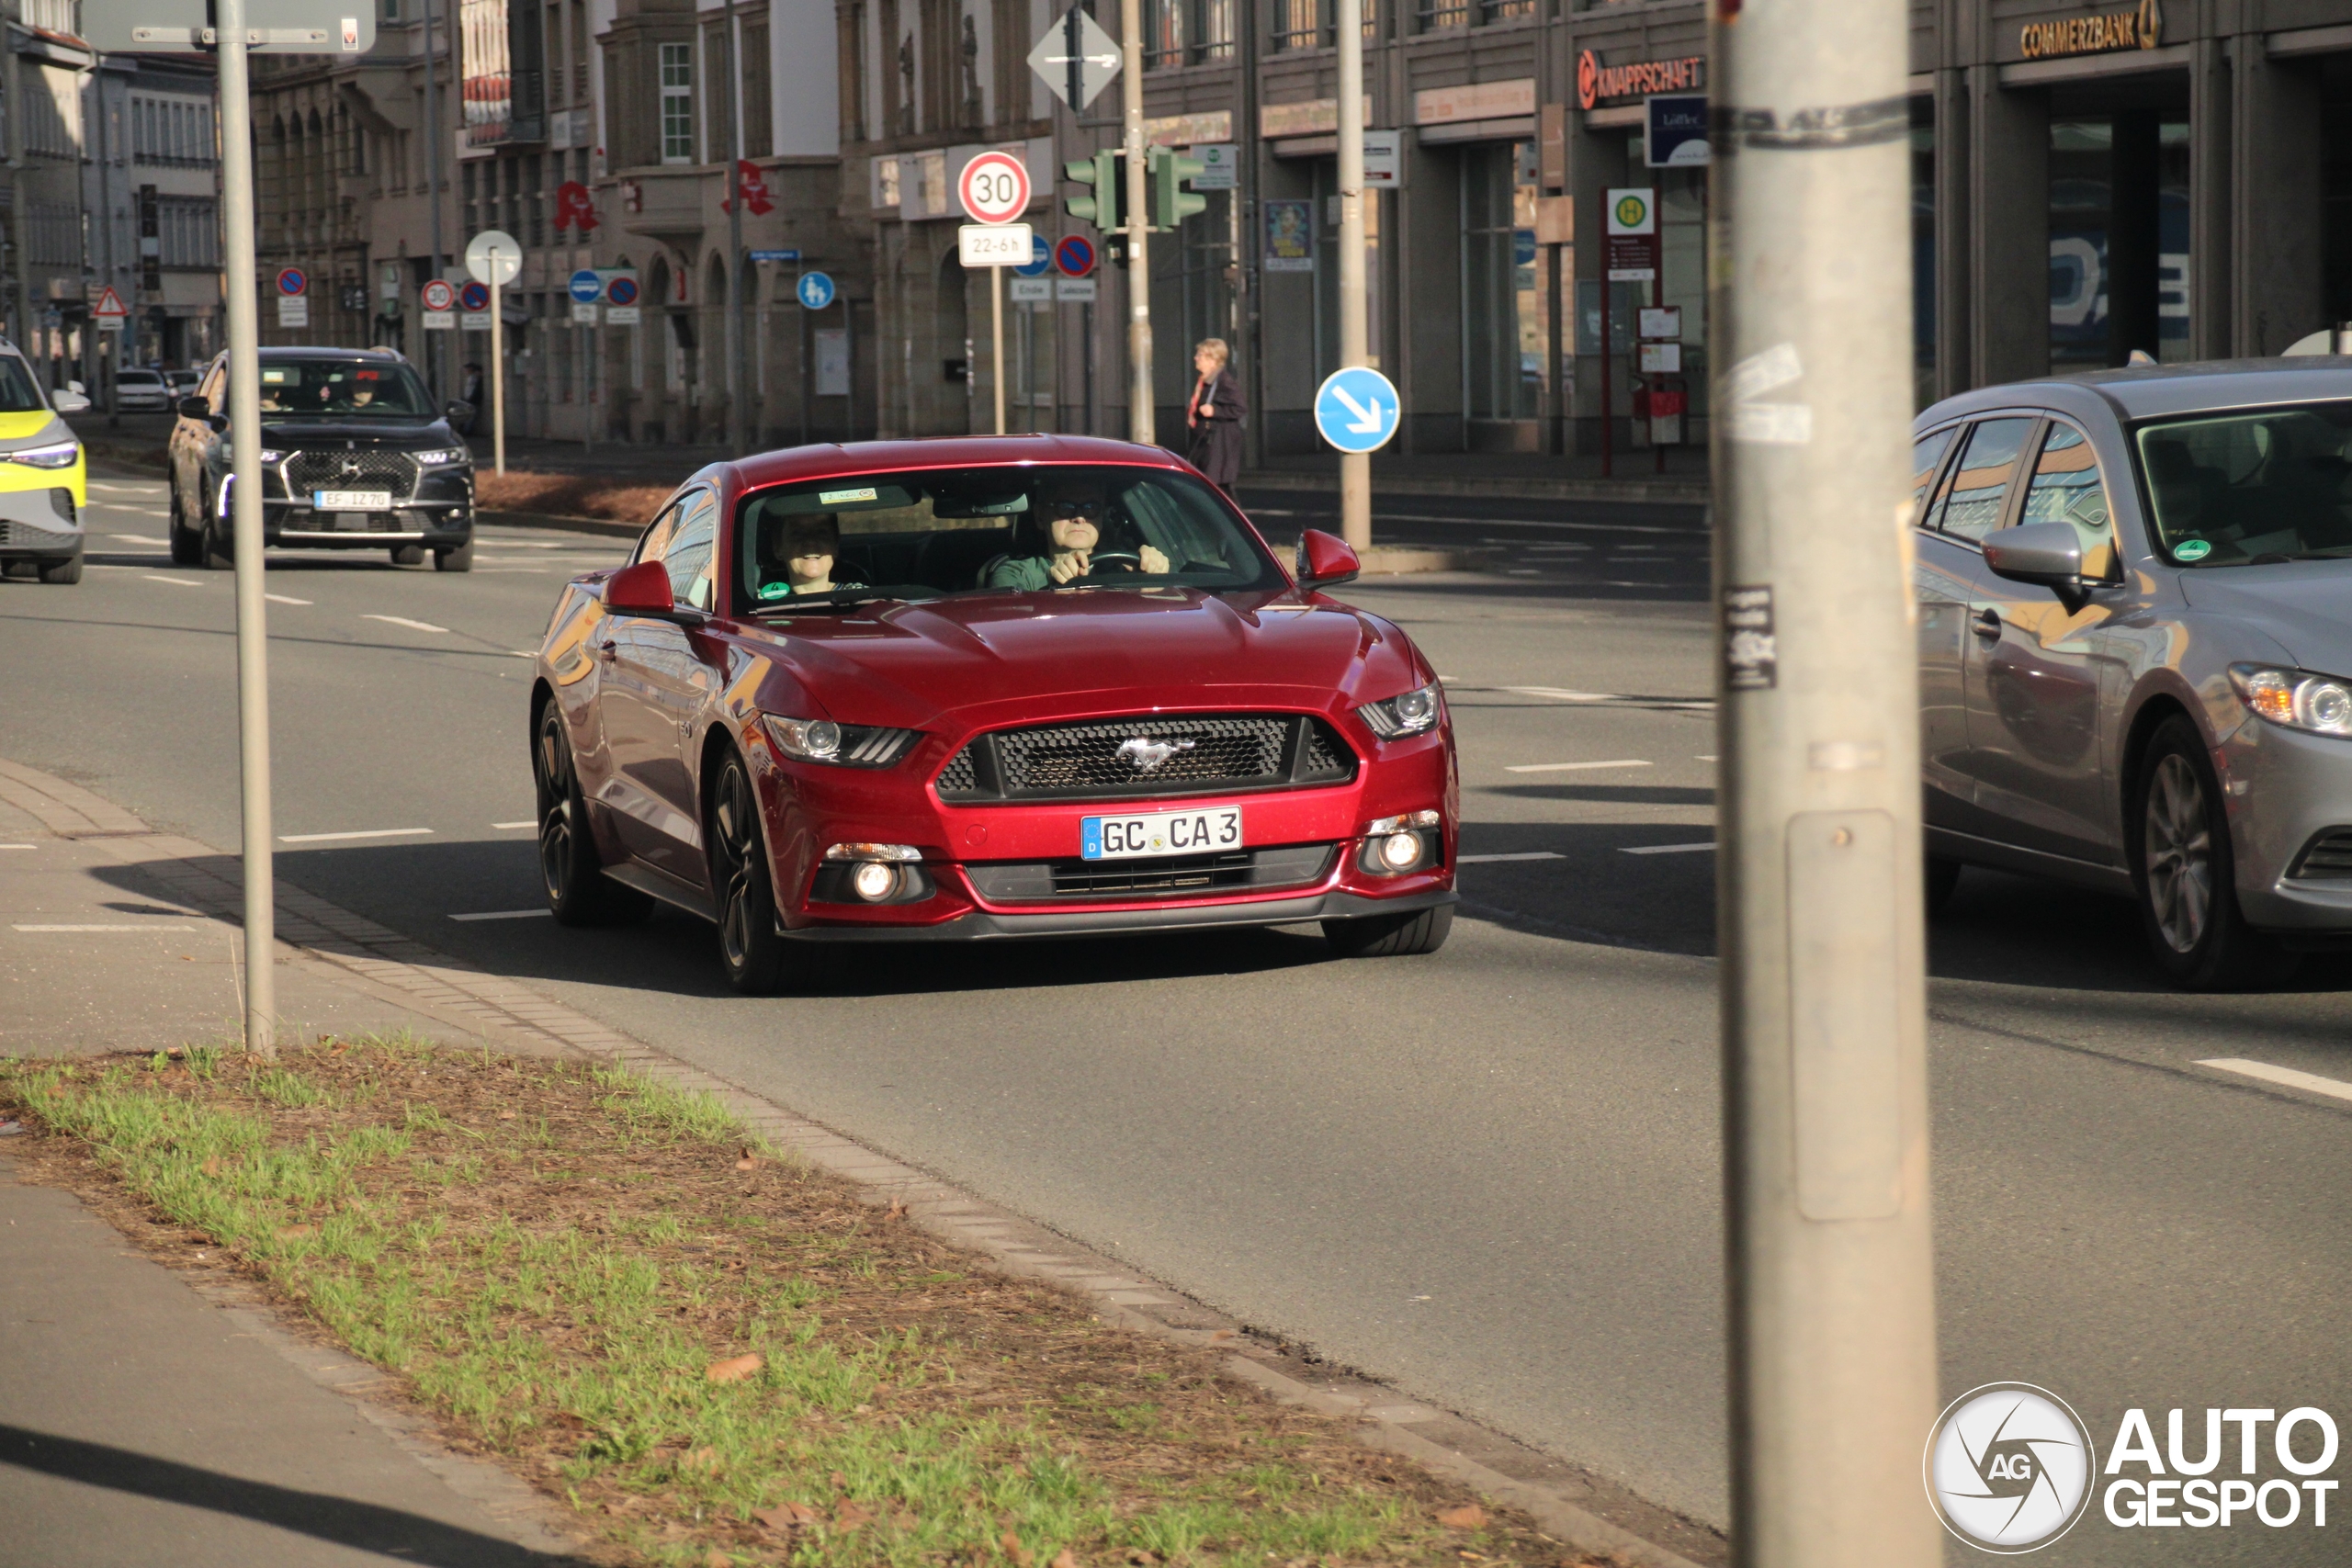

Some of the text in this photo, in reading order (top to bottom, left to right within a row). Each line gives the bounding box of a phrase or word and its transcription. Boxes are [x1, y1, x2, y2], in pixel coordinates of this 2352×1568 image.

[2021, 12, 2135, 57] COMMERZBANK
[1597, 57, 1700, 96] KNAPPSCHAFT
[976, 174, 1013, 203] 30
[430, 288, 447, 302] 30
[1019, 284, 1044, 293] Ende
[326, 493, 343, 505] EF
[369, 494, 385, 505] 70
[2188, 541, 2199, 549] 4
[1103, 813, 1237, 852] GC CA 3
[1089, 842, 1096, 852] D
